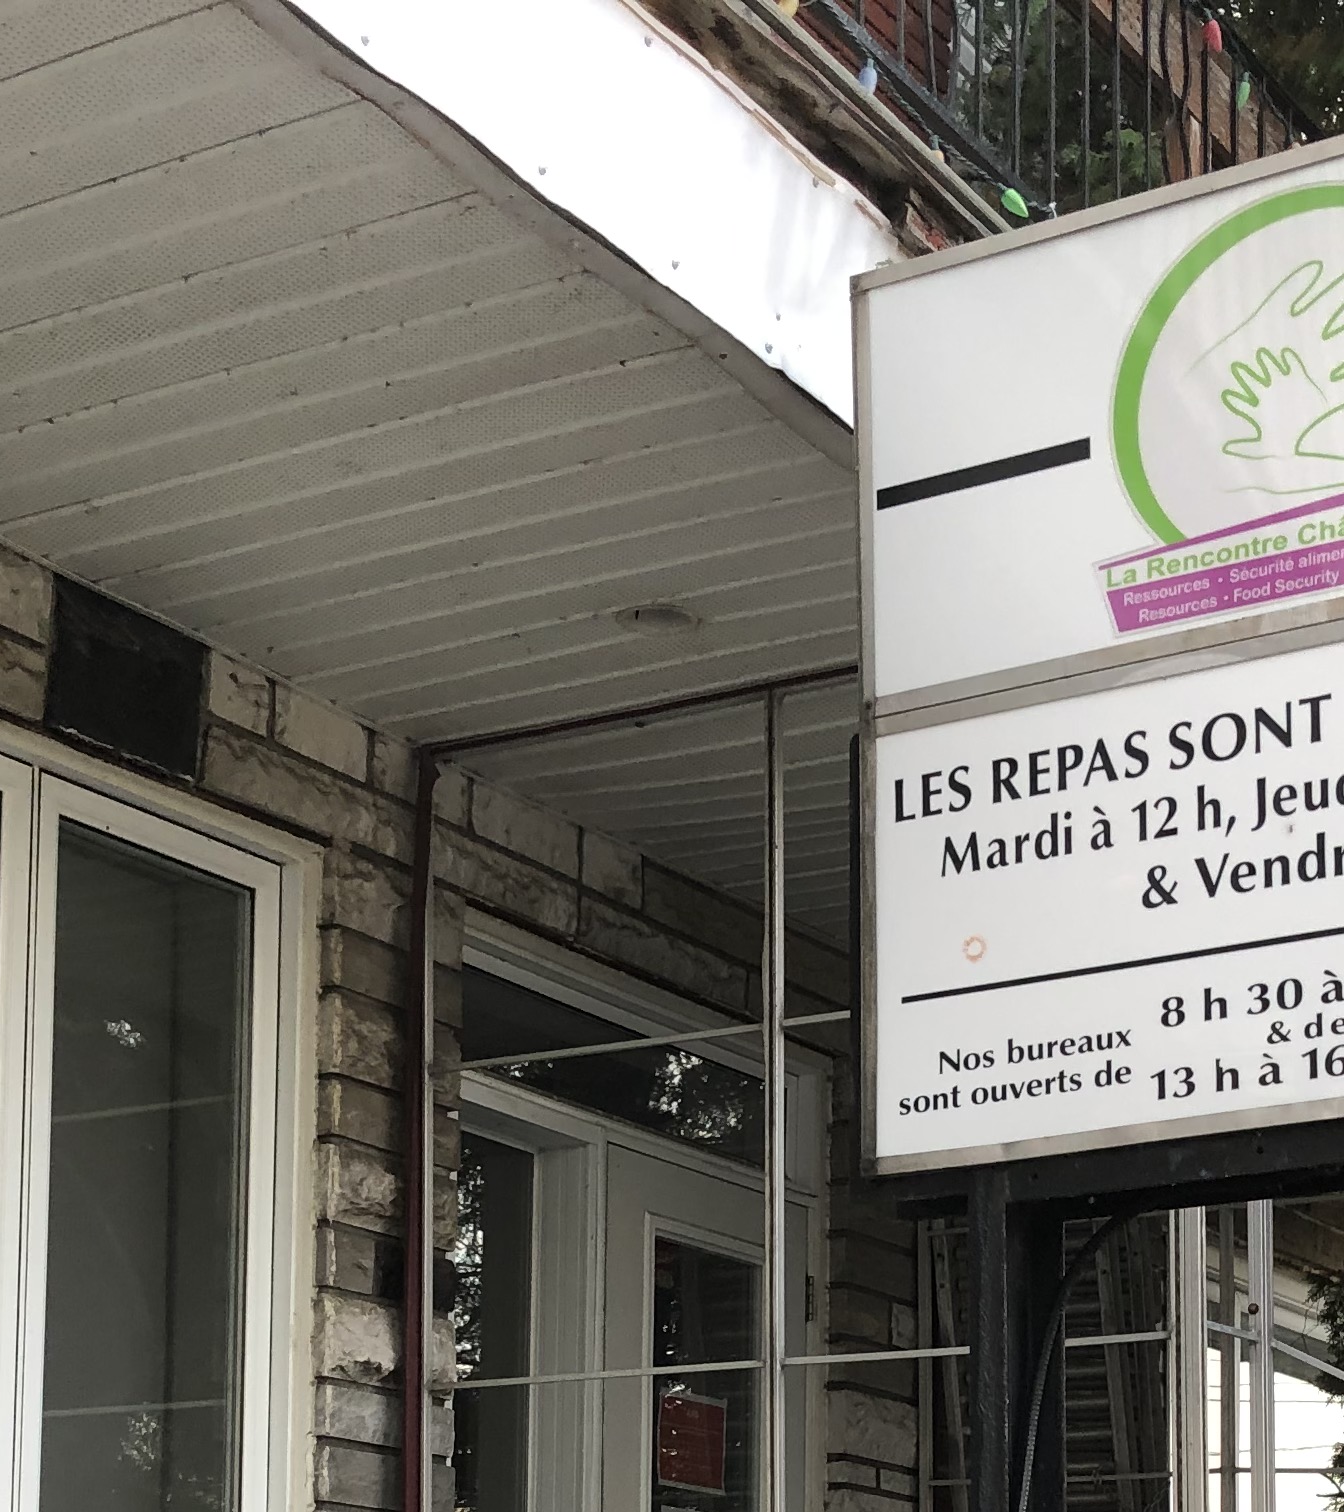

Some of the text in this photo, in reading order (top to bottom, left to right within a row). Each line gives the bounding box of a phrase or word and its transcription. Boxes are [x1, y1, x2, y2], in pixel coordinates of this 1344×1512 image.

[1106, 565, 1136, 589] La
[1147, 534, 1288, 579] Rencontre
[1123, 576, 1210, 607] Ressources
[1230, 555, 1294, 585] Sécurité
[1138, 595, 1218, 623] Resources
[1233, 582, 1271, 602] Food
[1274, 568, 1340, 595] Security
[895, 765, 972, 823] LES
[992, 730, 1150, 804] REPAS
[1169, 693, 1332, 770] SONT
[941, 810, 1073, 877] Mardi
[1090, 806, 1115, 851] à
[1130, 796, 1179, 842] 12
[1197, 784, 1237, 838] h,
[1141, 864, 1179, 909] &
[1160, 996, 1186, 1028] 8
[1203, 987, 1229, 1022] h
[1247, 977, 1304, 1016] 30
[939, 1028, 1132, 1074] Nos bureaux
[1266, 1019, 1292, 1045] &
[899, 1059, 1133, 1116] sont ouverts de
[1150, 1067, 1196, 1101] 13
[1215, 1058, 1240, 1093] h
[1258, 1053, 1284, 1088] à
